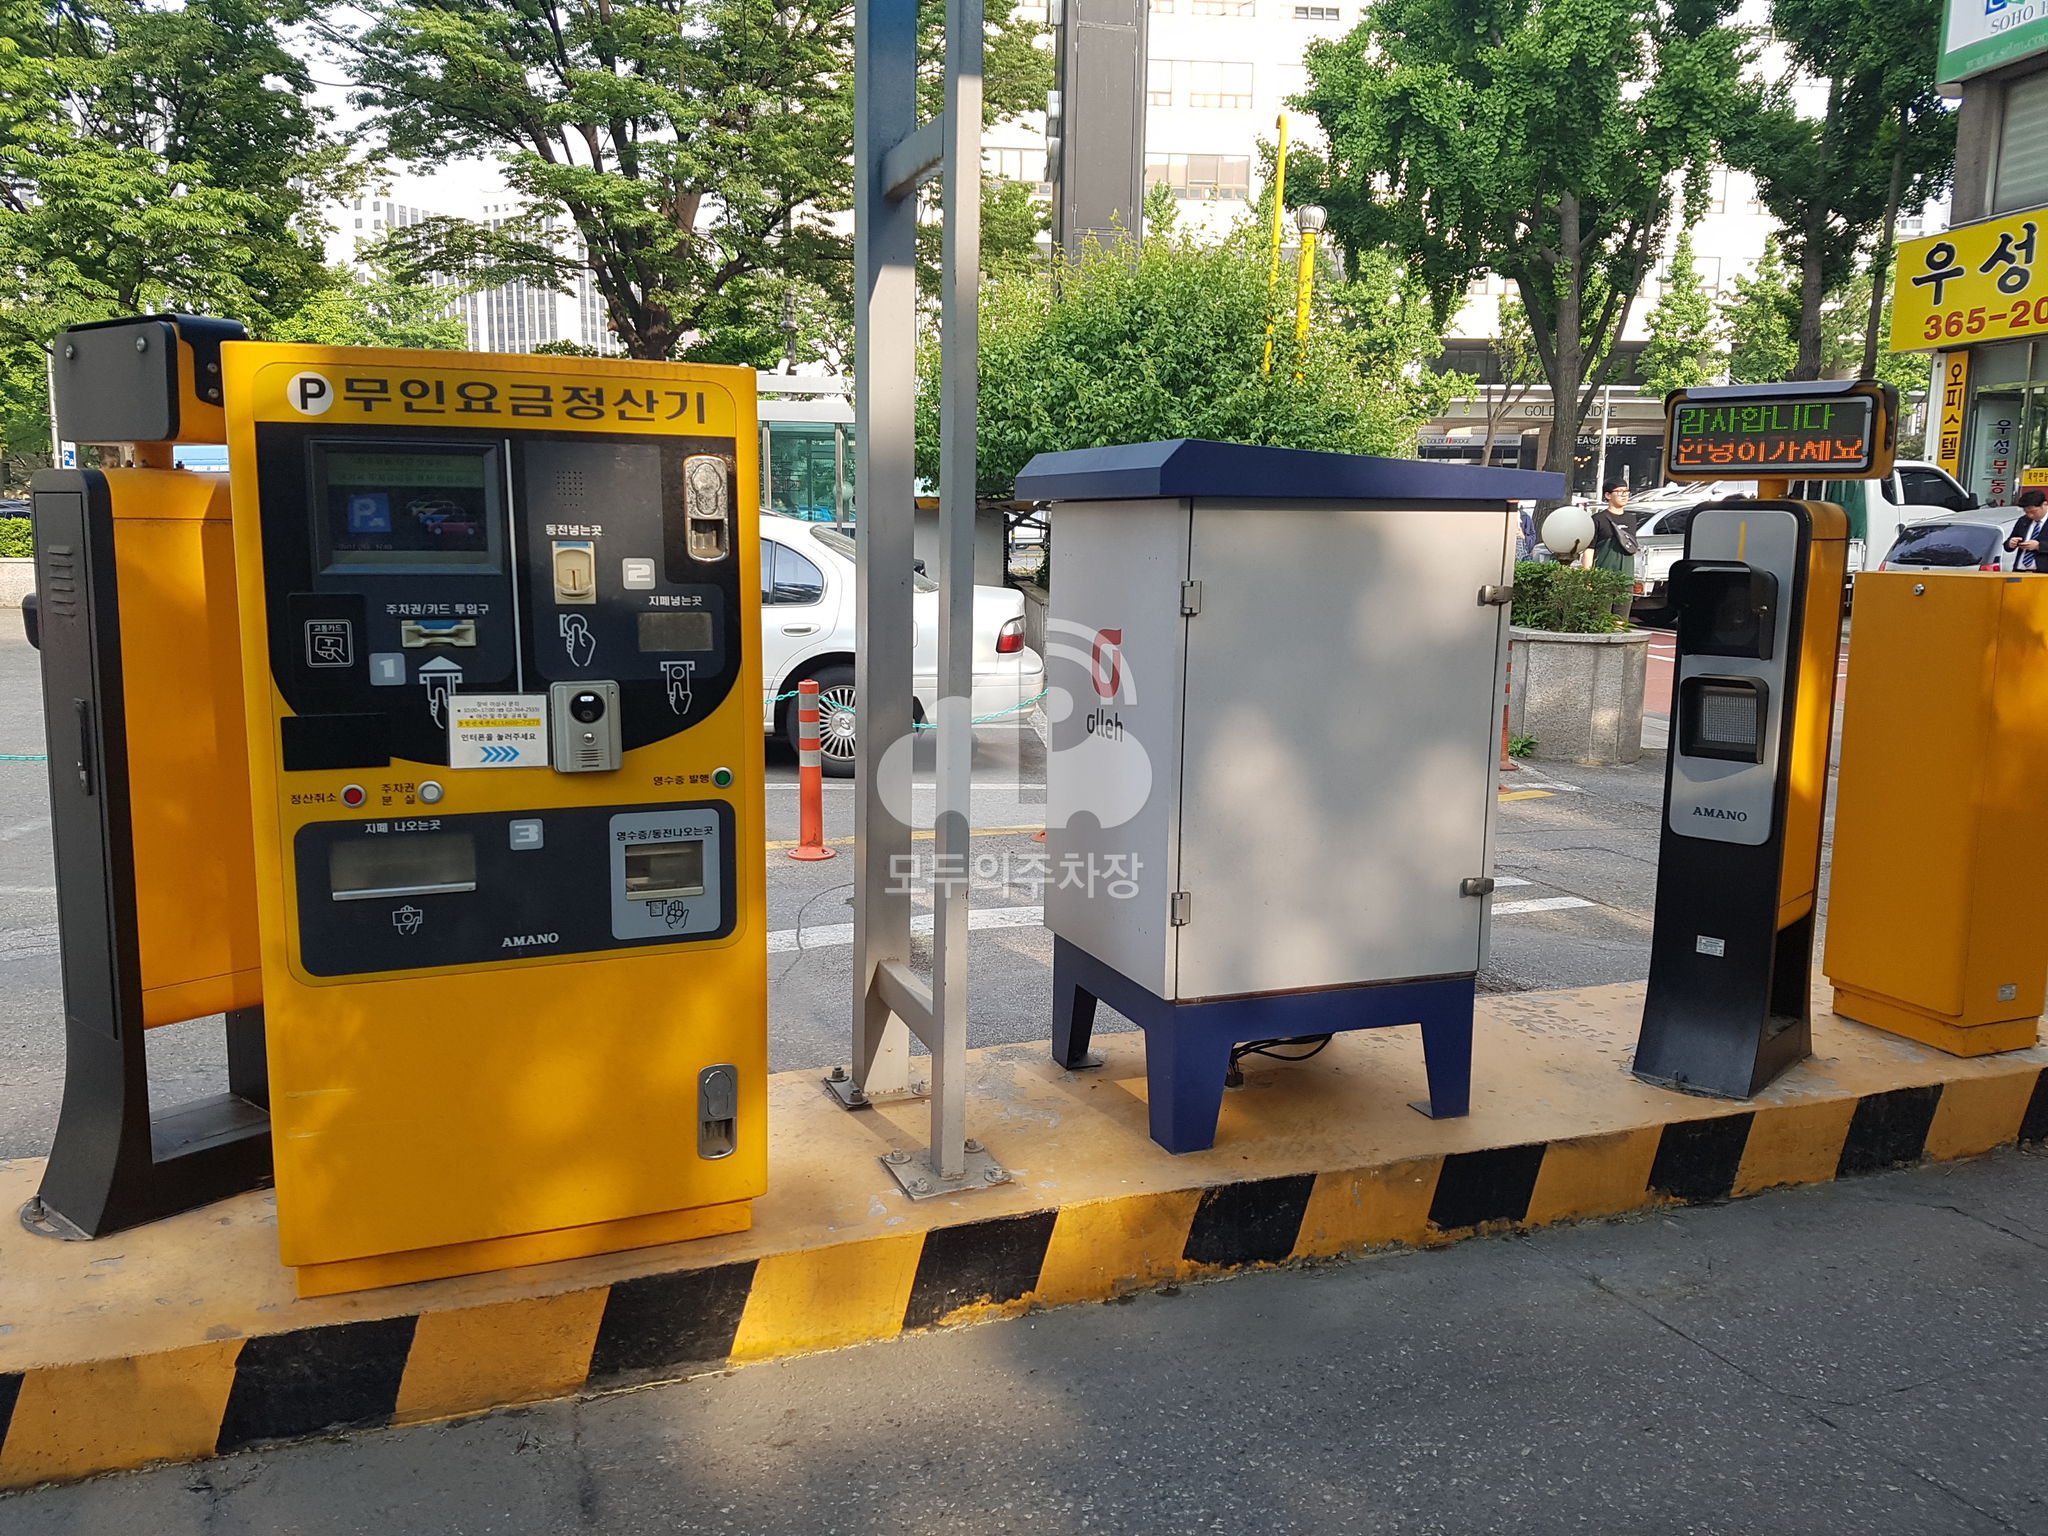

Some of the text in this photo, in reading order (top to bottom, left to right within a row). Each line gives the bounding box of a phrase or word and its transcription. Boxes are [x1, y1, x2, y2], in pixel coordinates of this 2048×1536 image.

[1990, 5, 2034, 34] SOHO
[1911, 222, 2037, 306] 우성
[299, 377, 326, 410] P
[344, 378, 705, 424] 무인요금정산기
[1681, 404, 1836, 435] 감사합니다
[1941, 363, 1963, 460] 오피스텔
[1604, 436, 1637, 446] COFFEE
[545, 524, 603, 536] 동전넣는곳
[627, 564, 651, 582] 2
[386, 603, 490, 615] 주차권/카드 투입구
[380, 658, 395, 678] 1
[1086, 708, 1124, 742] olleh
[381, 783, 415, 794] 주차권
[653, 774, 710, 786] 영수증 발행
[290, 793, 337, 805] 정산취소
[1692, 806, 1748, 822] AMANO
[394, 819, 441, 832] 나오는곳
[514, 824, 539, 843] 3
[616, 825, 713, 842] 영수증/동전나오는곳
[501, 932, 560, 948] AMANO
